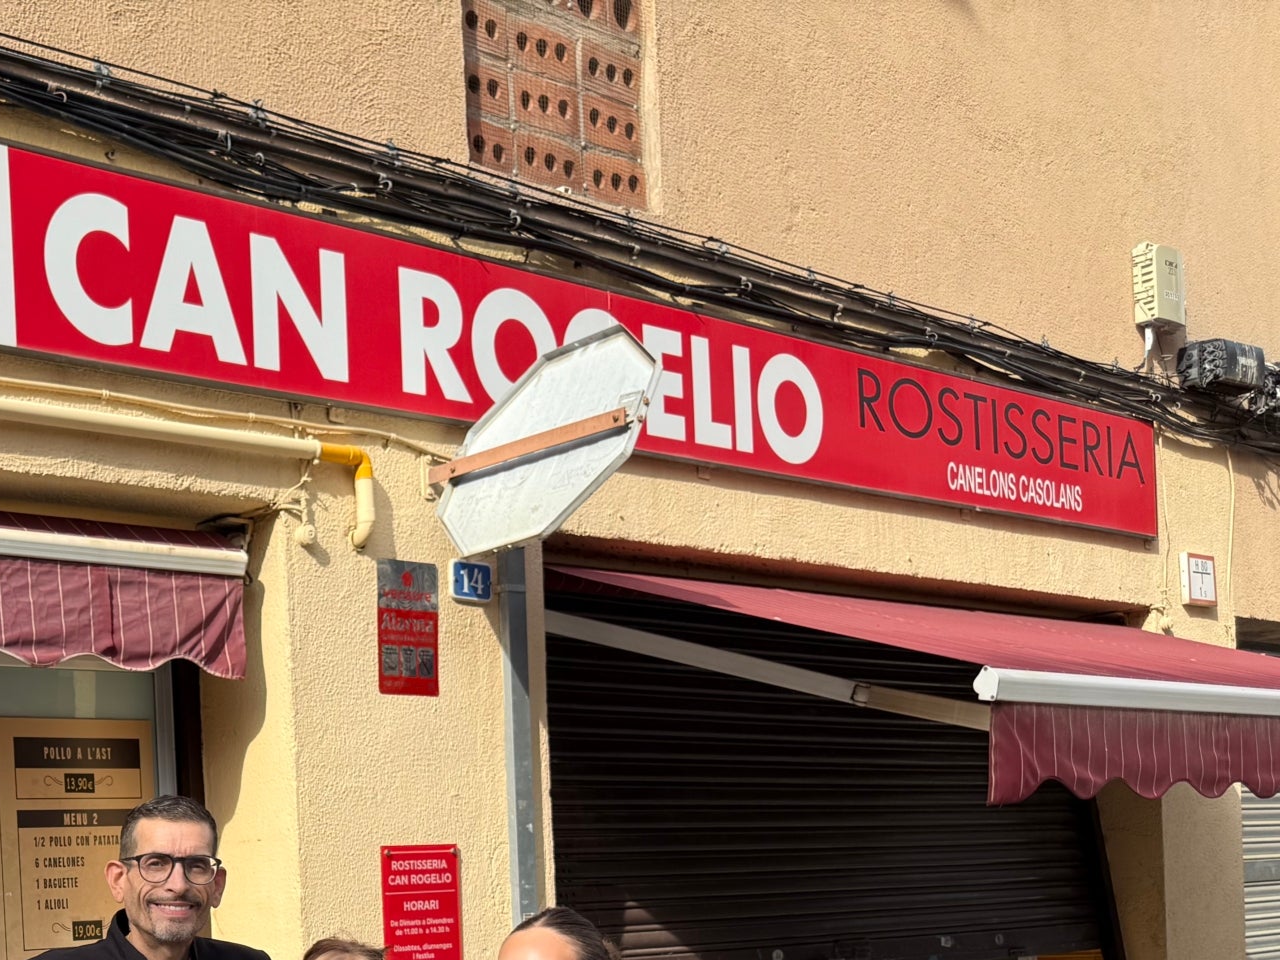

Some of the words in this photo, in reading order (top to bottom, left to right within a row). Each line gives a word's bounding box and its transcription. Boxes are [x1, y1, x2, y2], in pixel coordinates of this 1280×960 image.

[44, 192, 350, 383] CAN
[397, 266, 822, 464] ROELIO
[857, 368, 1146, 485] ROSTISSERIA
[947, 461, 1017, 502] CANELONS
[1019, 475, 1083, 513] CASOLANS
[460, 568, 484, 595] 14
[381, 612, 435, 633] Alarma
[43, 746, 71, 760] POLLO
[77, 747, 83, 760] A
[87, 746, 112, 761] L'AST
[66, 776, 93, 792] 13,90€
[63, 813, 88, 826] MENU
[92, 813, 98, 825] 2
[33, 836, 46, 847] 1/2
[49, 835, 72, 847] POLLO
[75, 835, 90, 846] CON
[93, 834, 120, 846] PATATA
[34, 857, 40, 869] 6
[43, 856, 85, 868] CANELONES
[391, 859, 448, 871] ROSTISSERIA
[35, 878, 40, 890] 1
[43, 877, 79, 889] BAGUETTE
[388, 874, 409, 886] CAN
[410, 872, 452, 885] ROGELIO
[37, 899, 41, 910] 1
[44, 898, 69, 910] ALIOLI
[403, 899, 439, 912] HORARI
[390, 919, 399, 927] De
[74, 924, 102, 939] 19,00€
